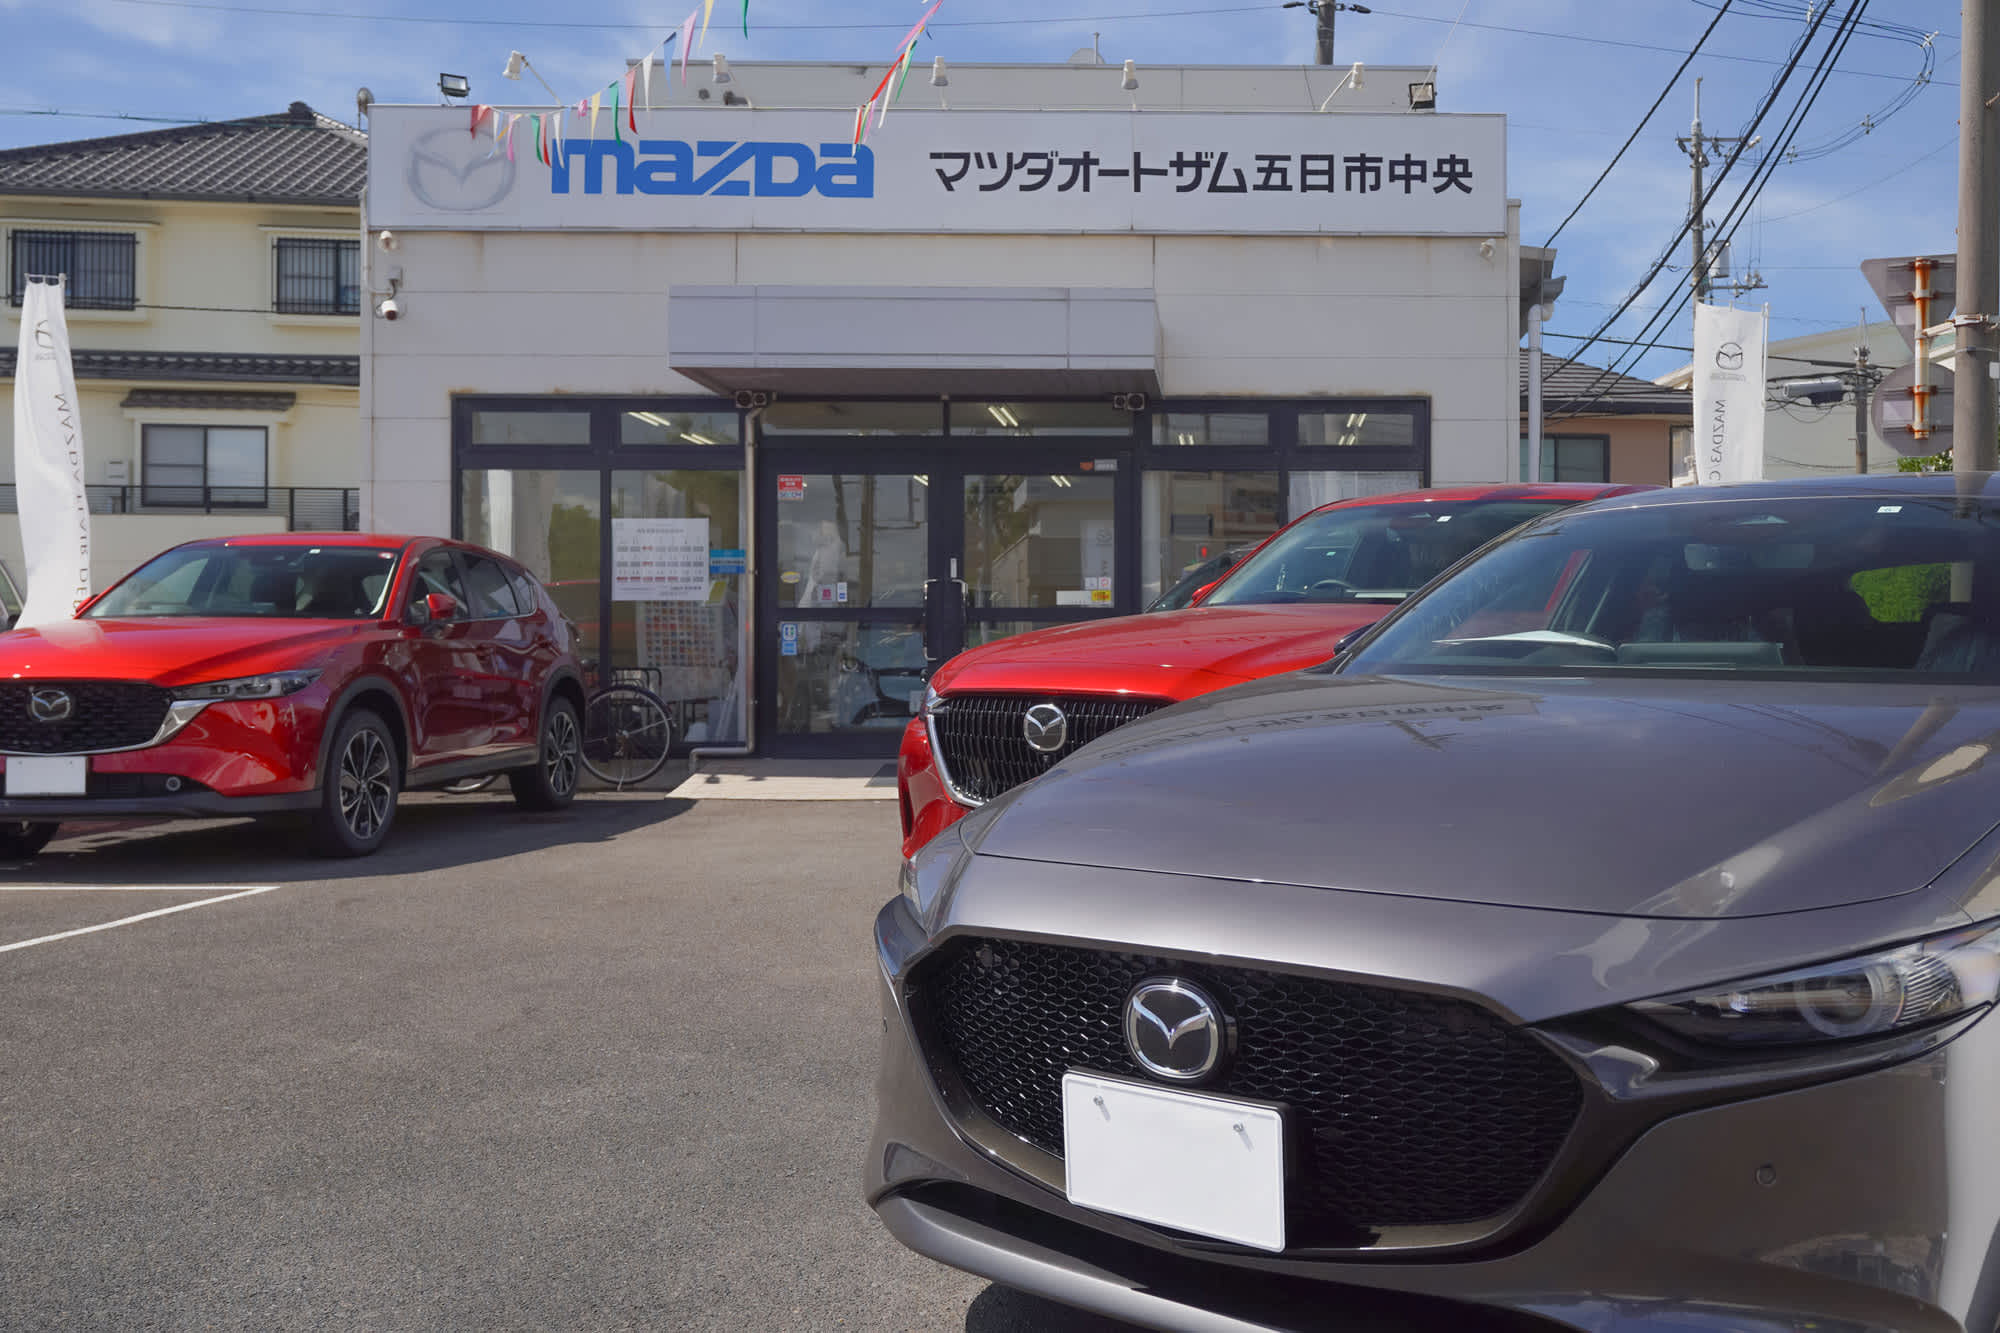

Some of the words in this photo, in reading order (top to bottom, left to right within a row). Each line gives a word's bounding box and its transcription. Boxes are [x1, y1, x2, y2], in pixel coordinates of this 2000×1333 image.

[929, 150, 1474, 195] マツダオートザム五日市中央
